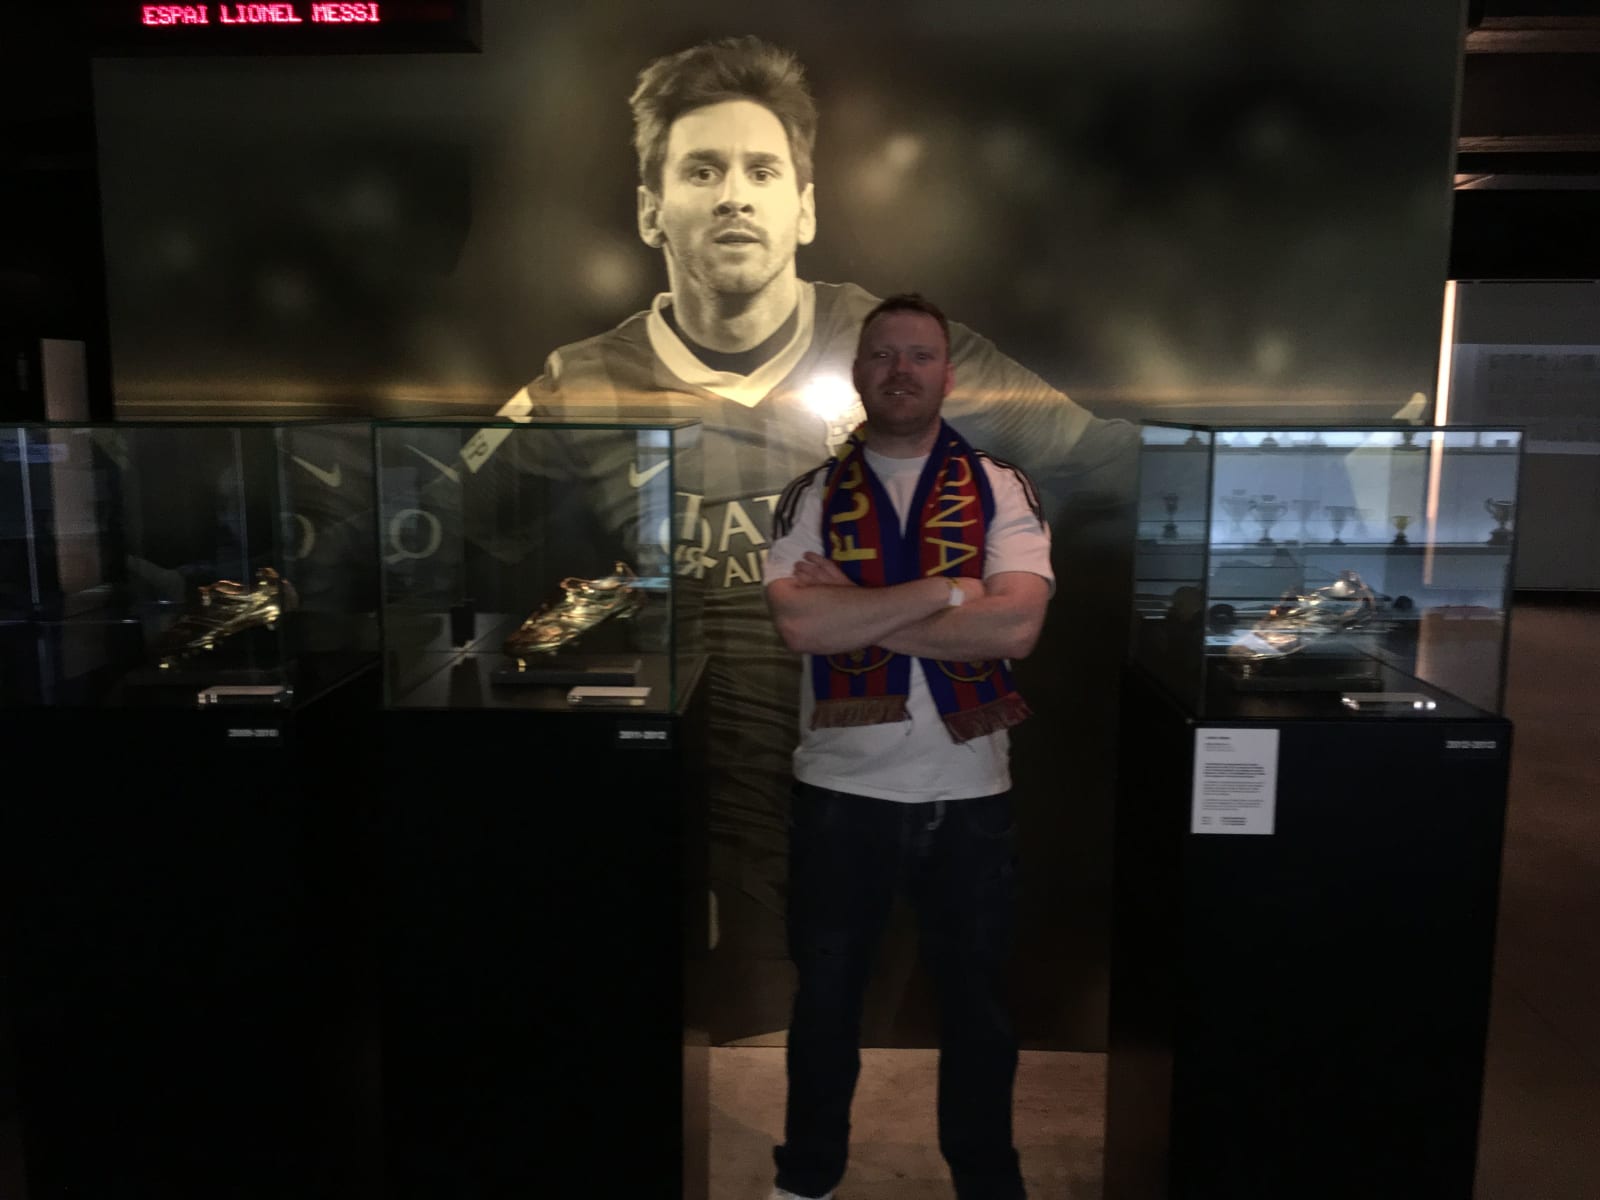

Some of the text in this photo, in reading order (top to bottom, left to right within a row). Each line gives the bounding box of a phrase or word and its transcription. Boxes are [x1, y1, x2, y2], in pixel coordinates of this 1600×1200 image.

[143, 3, 380, 24] ESPAI LIONEL MESSI
